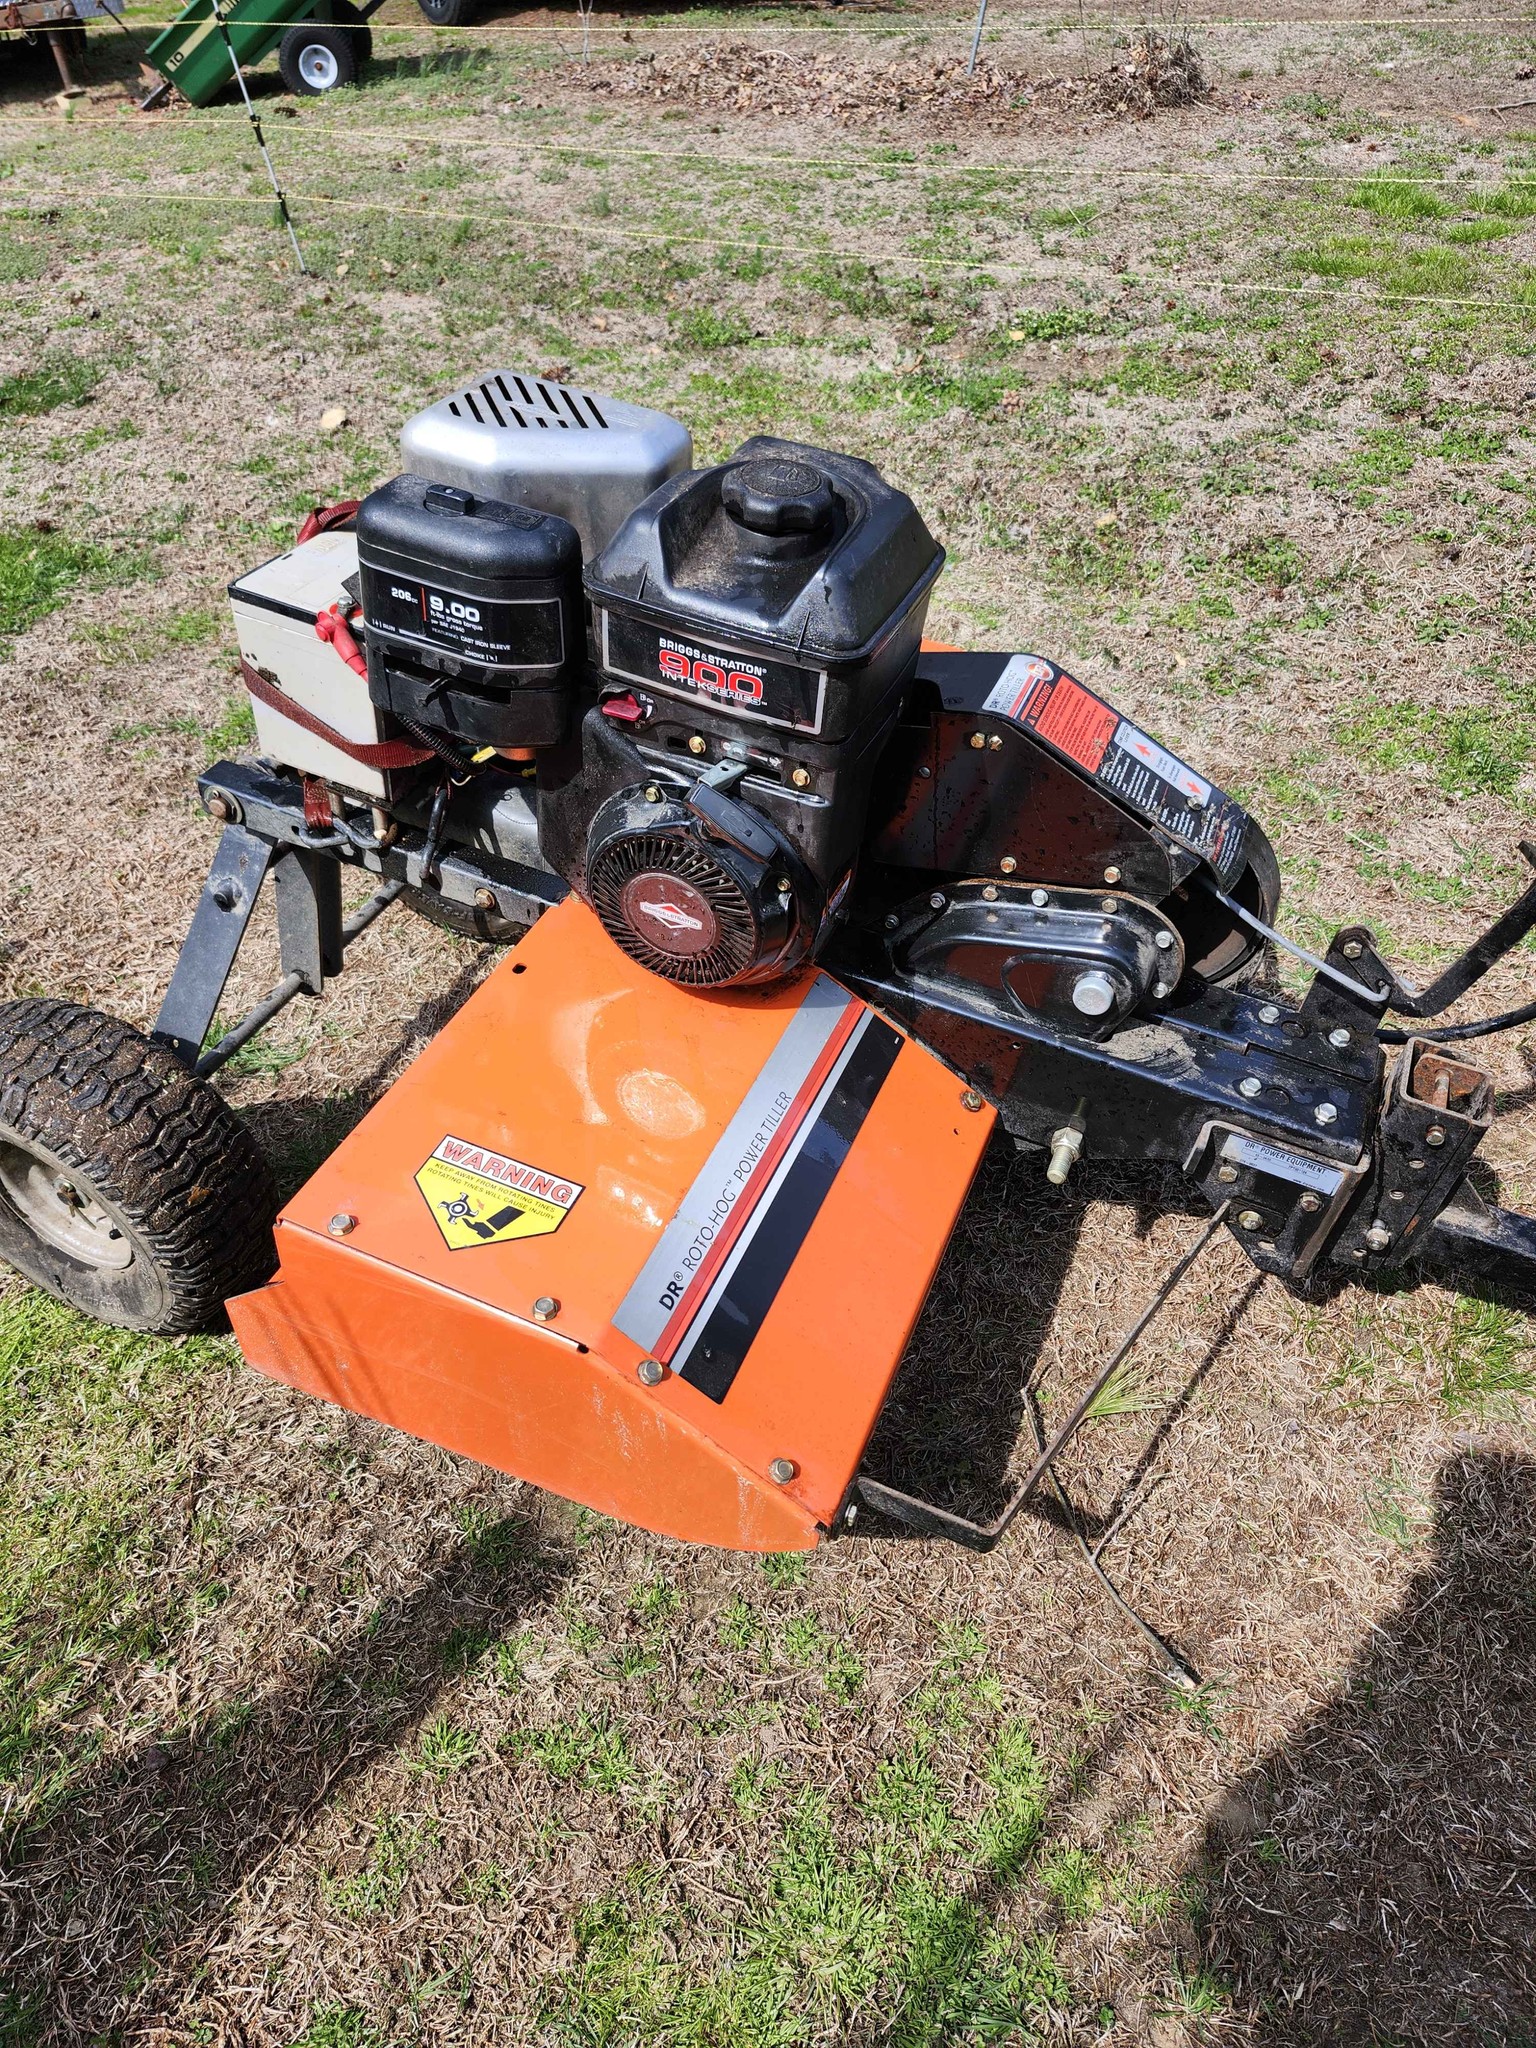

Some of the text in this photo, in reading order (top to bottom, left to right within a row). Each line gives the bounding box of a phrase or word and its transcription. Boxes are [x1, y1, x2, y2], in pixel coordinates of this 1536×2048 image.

[170, 51, 184, 67] 10
[430, 595, 480, 623] 9.00
[659, 649, 764, 700] 900
[733, 1132, 768, 1182] POWER
[760, 1091, 792, 1132] TILLER
[1260, 1147, 1286, 1160] POWER
[1286, 1157, 1327, 1175] EQUIPMENT
[427, 1167, 556, 1221] ROTATING TINES WILL CAUSE INJURY
[434, 1163, 556, 1213] KEEP AWAY FROM ROTATING TINES
[442, 1140, 573, 1205] WARNING
